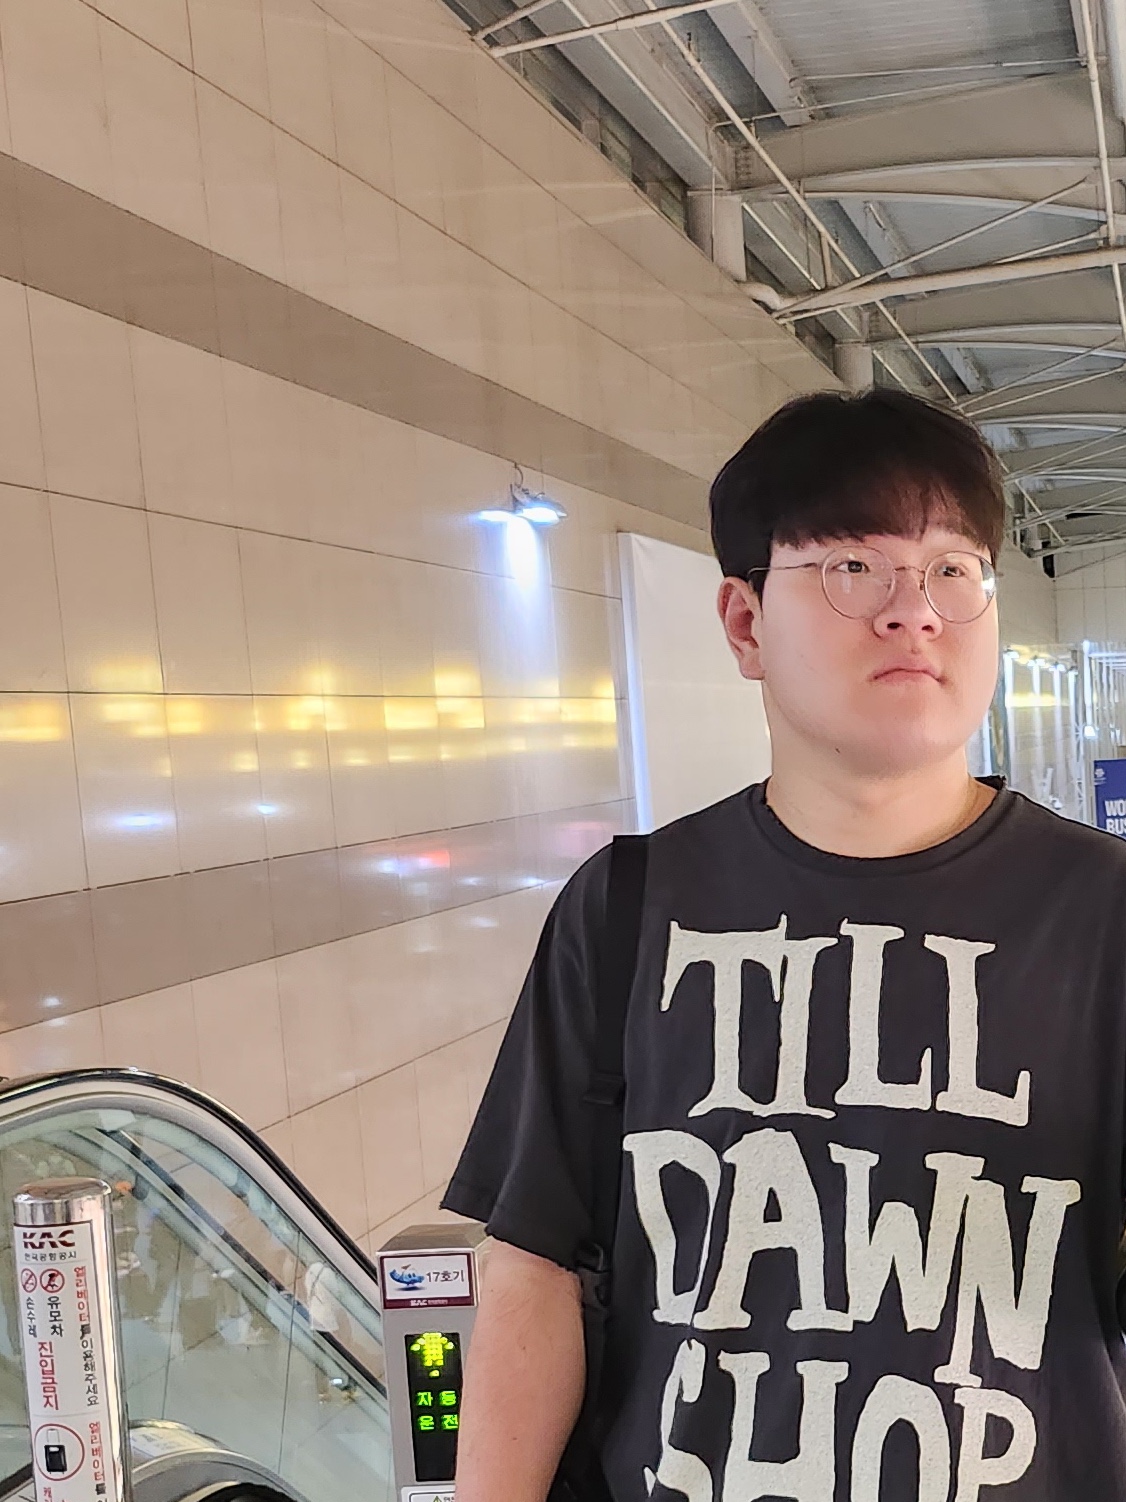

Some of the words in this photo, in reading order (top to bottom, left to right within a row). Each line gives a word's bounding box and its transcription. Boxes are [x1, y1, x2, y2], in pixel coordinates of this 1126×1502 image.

[660, 914, 1031, 1126] TILL
[23, 1229, 76, 1250] KAC
[623, 1128, 1081, 1387] DAWN
[426, 1269, 465, 1283] 17호기
[47, 1295, 64, 1337] 유모차
[38, 1341, 59, 1411] 진입금지
